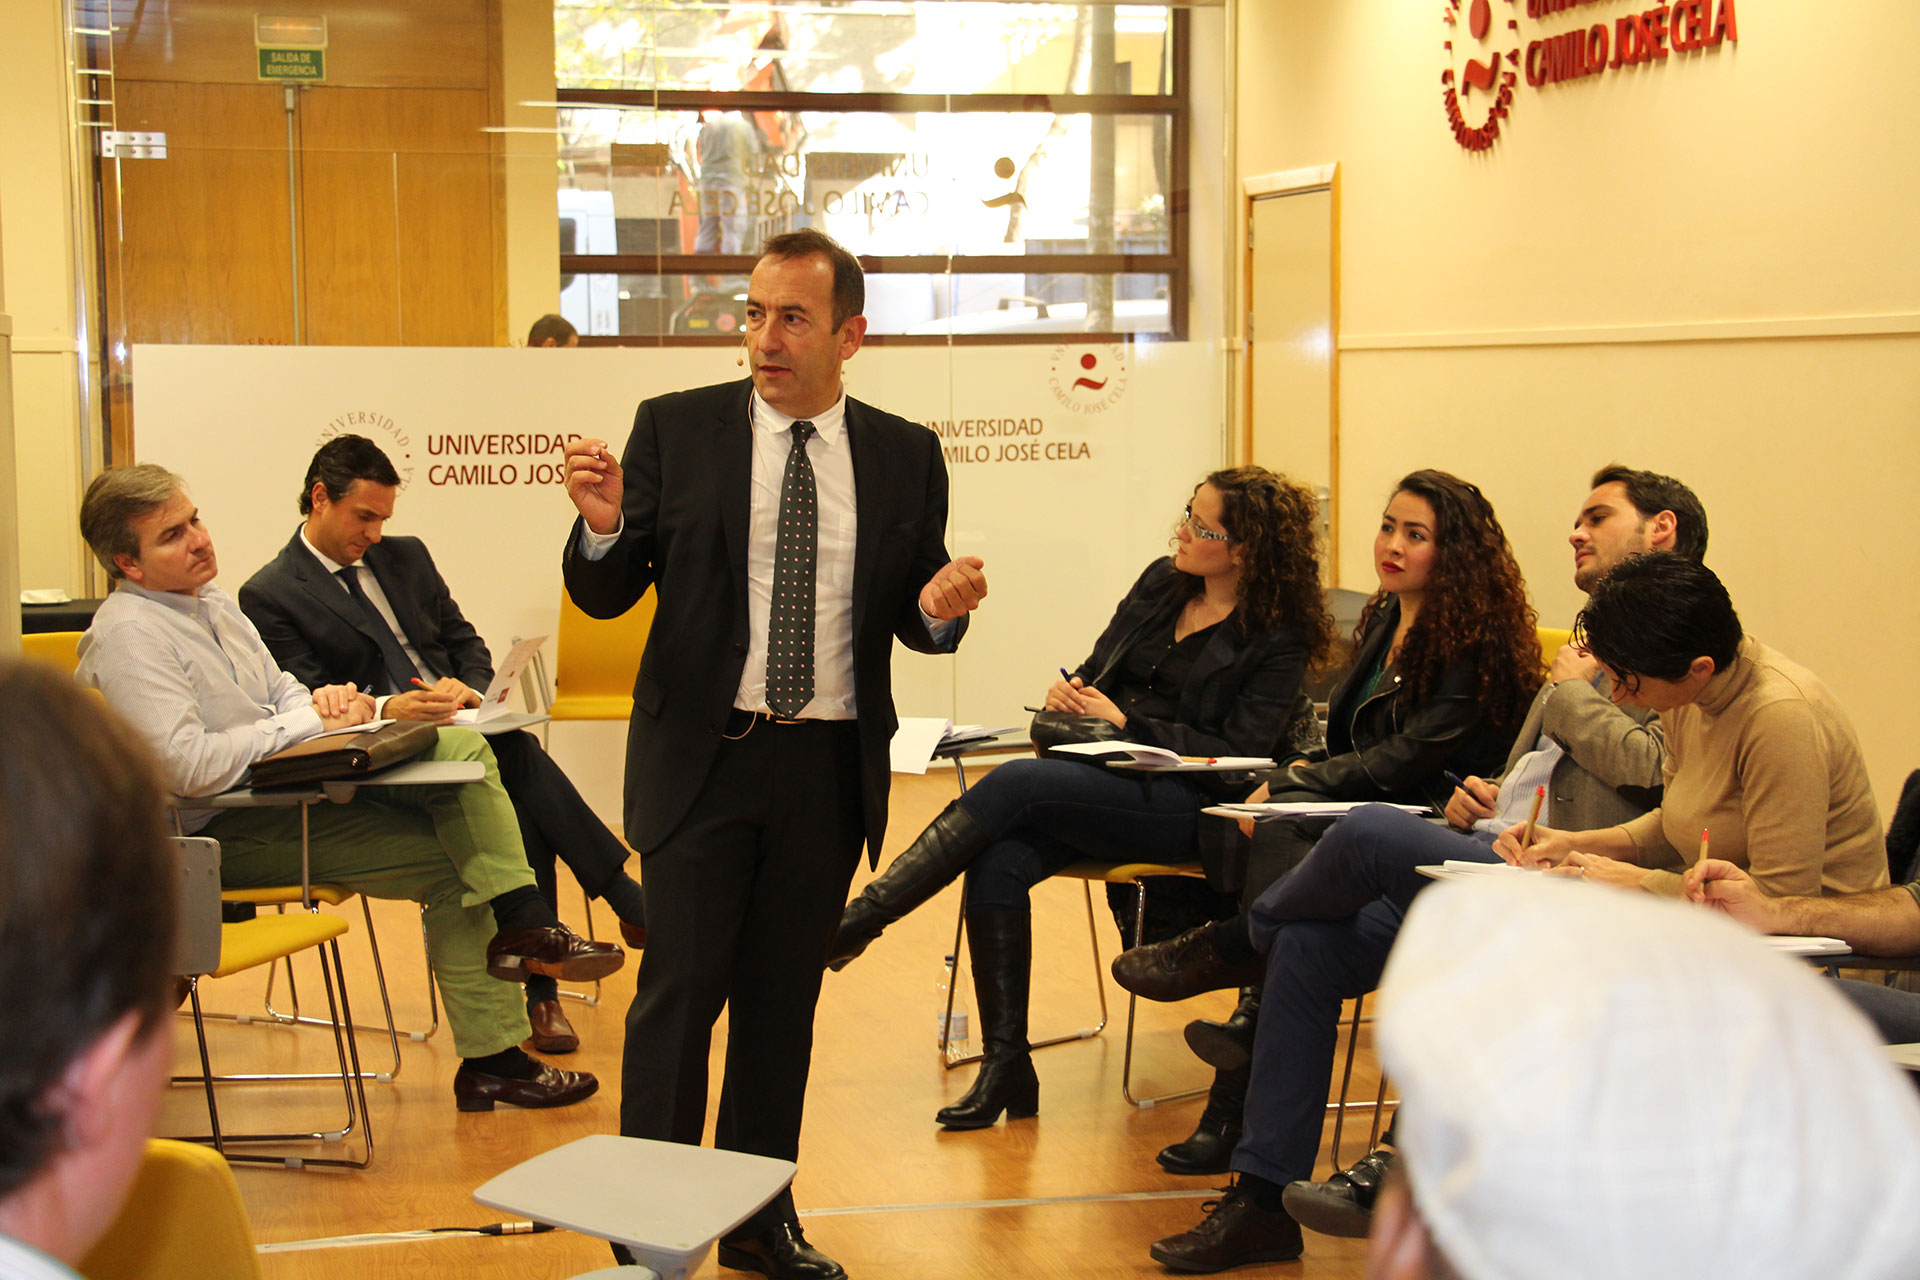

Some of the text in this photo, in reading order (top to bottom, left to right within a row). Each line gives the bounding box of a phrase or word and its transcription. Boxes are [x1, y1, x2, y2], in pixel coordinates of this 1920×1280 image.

[1526, 24, 1609, 87] CAMILO
[1671, 0, 1738, 52] CELA
[271, 52, 311, 63] SALIDA DE
[266, 64, 317, 76] EMERGENCIA
[918, 418, 1043, 438] NIVERSIDAD
[943, 439, 1091, 463] MILO JOSÉ CELA
[428, 464, 565, 486] CAMILO JOS
